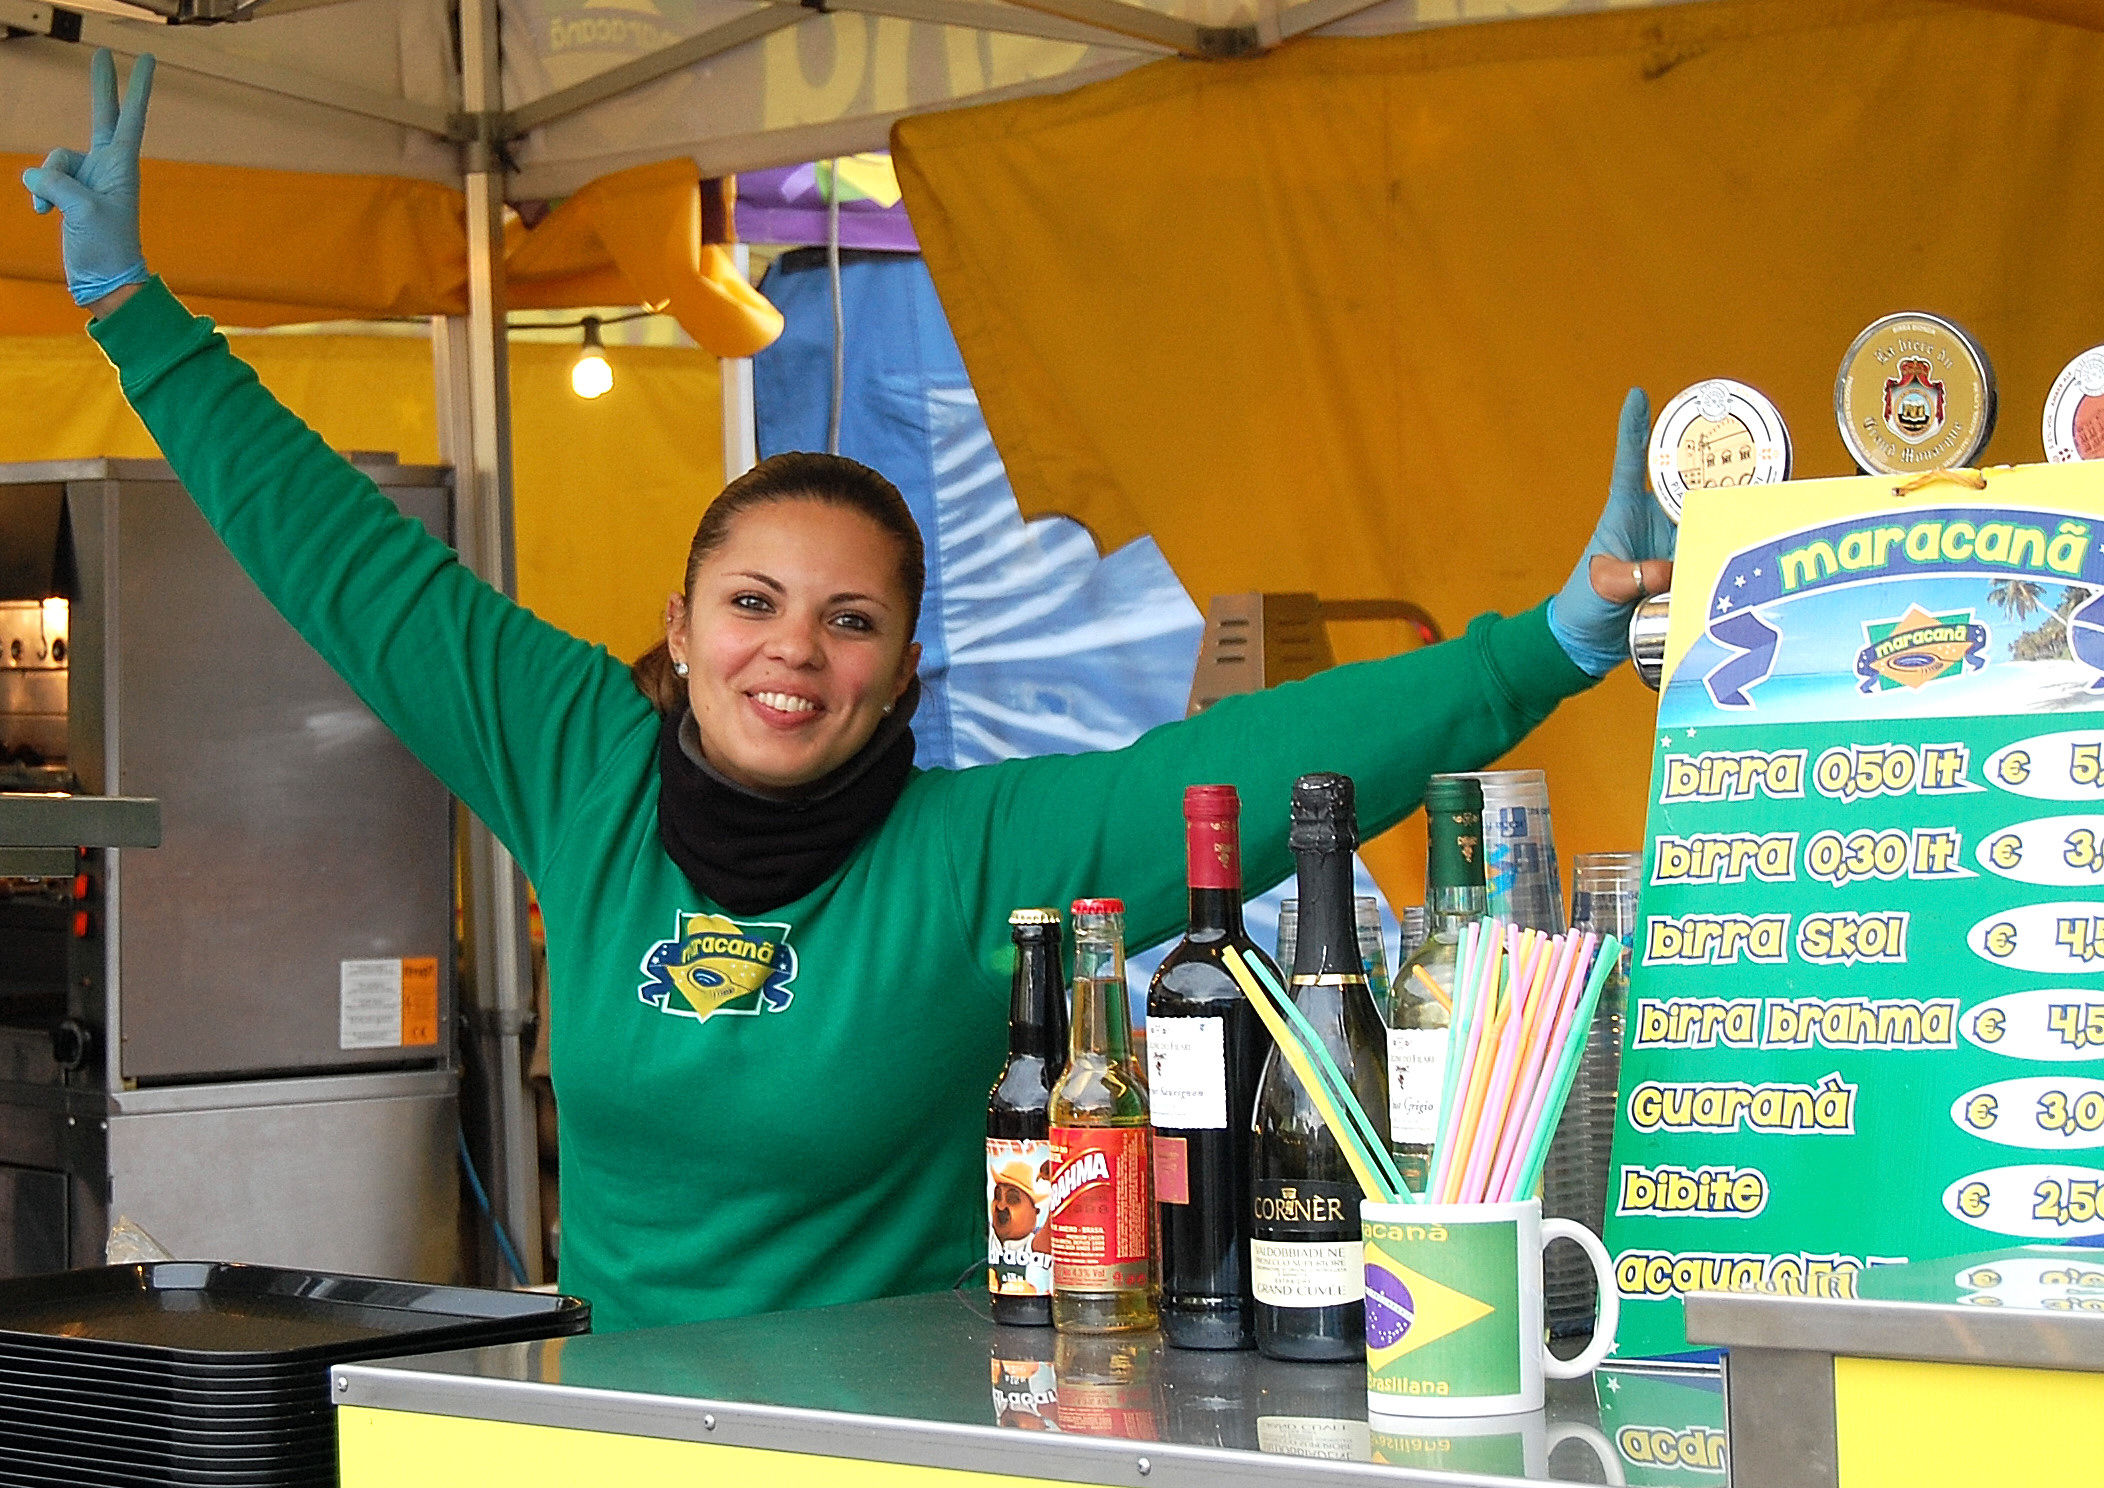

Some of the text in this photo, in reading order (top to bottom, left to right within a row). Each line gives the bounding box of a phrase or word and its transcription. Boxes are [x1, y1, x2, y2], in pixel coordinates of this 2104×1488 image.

[1777, 519, 2089, 592] maracanã
[1875, 625, 1968, 658] maracanã
[1665, 755, 1802, 798] birra
[1817, 750, 1916, 797] 0,50
[1921, 748, 1965, 788] lt
[1998, 750, 2031, 785] €
[1656, 829, 2104, 881] birra 0,30 lt € 3,
[1648, 918, 1785, 960] birra
[1801, 917, 1904, 958] skol
[1984, 922, 2017, 958] €
[1638, 1002, 2104, 1050] birra brahma € 4,5
[1632, 1079, 2104, 1137] Guaranà € 3,0
[1622, 1170, 1762, 1212] bibite
[1957, 1182, 1990, 1218] €
